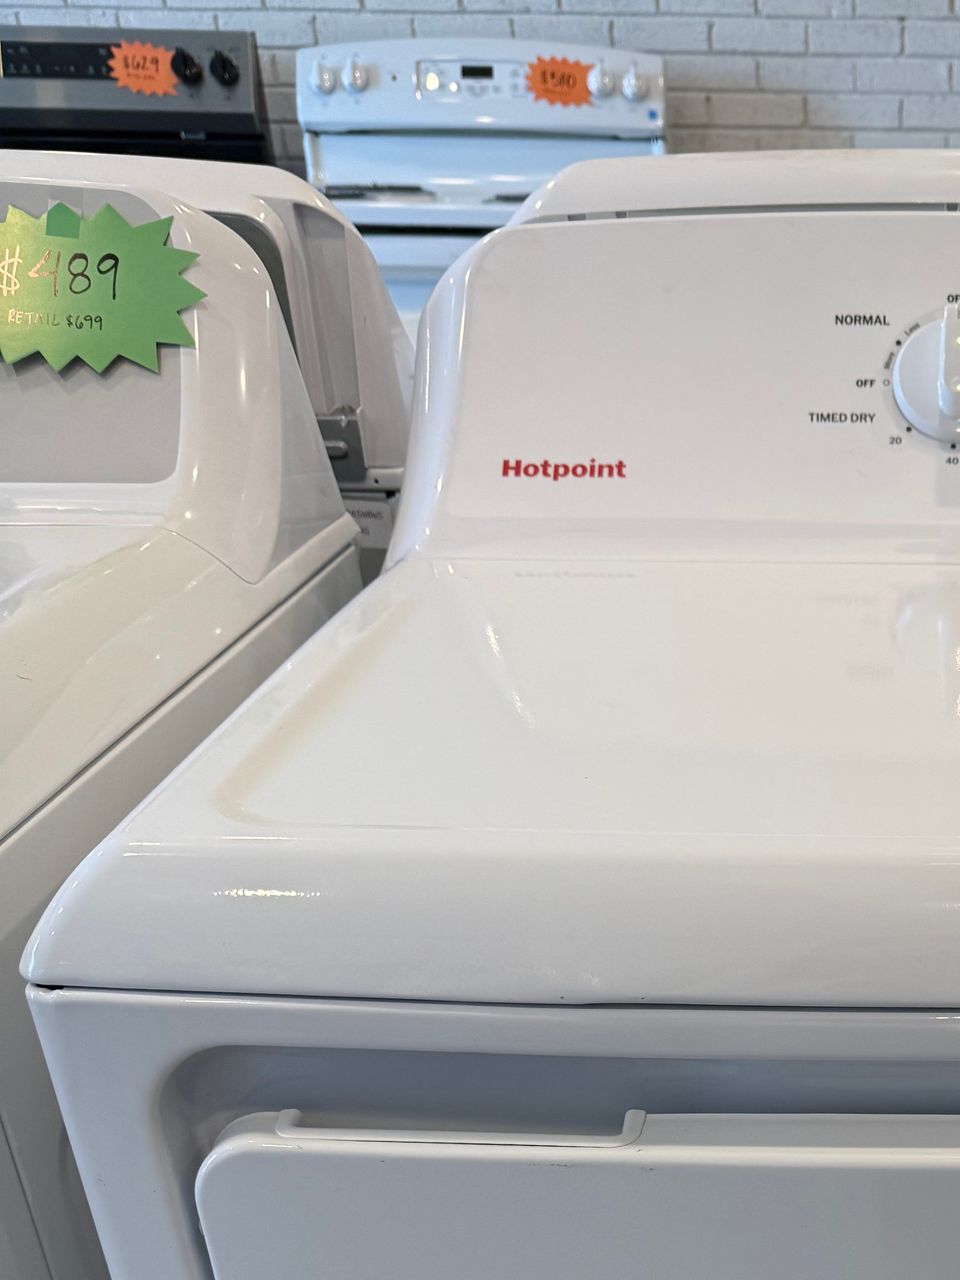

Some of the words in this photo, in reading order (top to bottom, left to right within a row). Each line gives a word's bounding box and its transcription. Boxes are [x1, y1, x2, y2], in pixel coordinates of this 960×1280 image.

[0, 245, 120, 301] $489
[7, 308, 60, 327] RETAIL
[65, 314, 103, 331] $699
[835, 314, 890, 326] NORMAL
[855, 378, 876, 389] OFF
[808, 412, 848, 424] TIMED
[850, 412, 876, 424] DRY
[889, 435, 903, 446] 20
[945, 456, 960, 466] 40
[502, 457, 627, 482] Hotpoint
